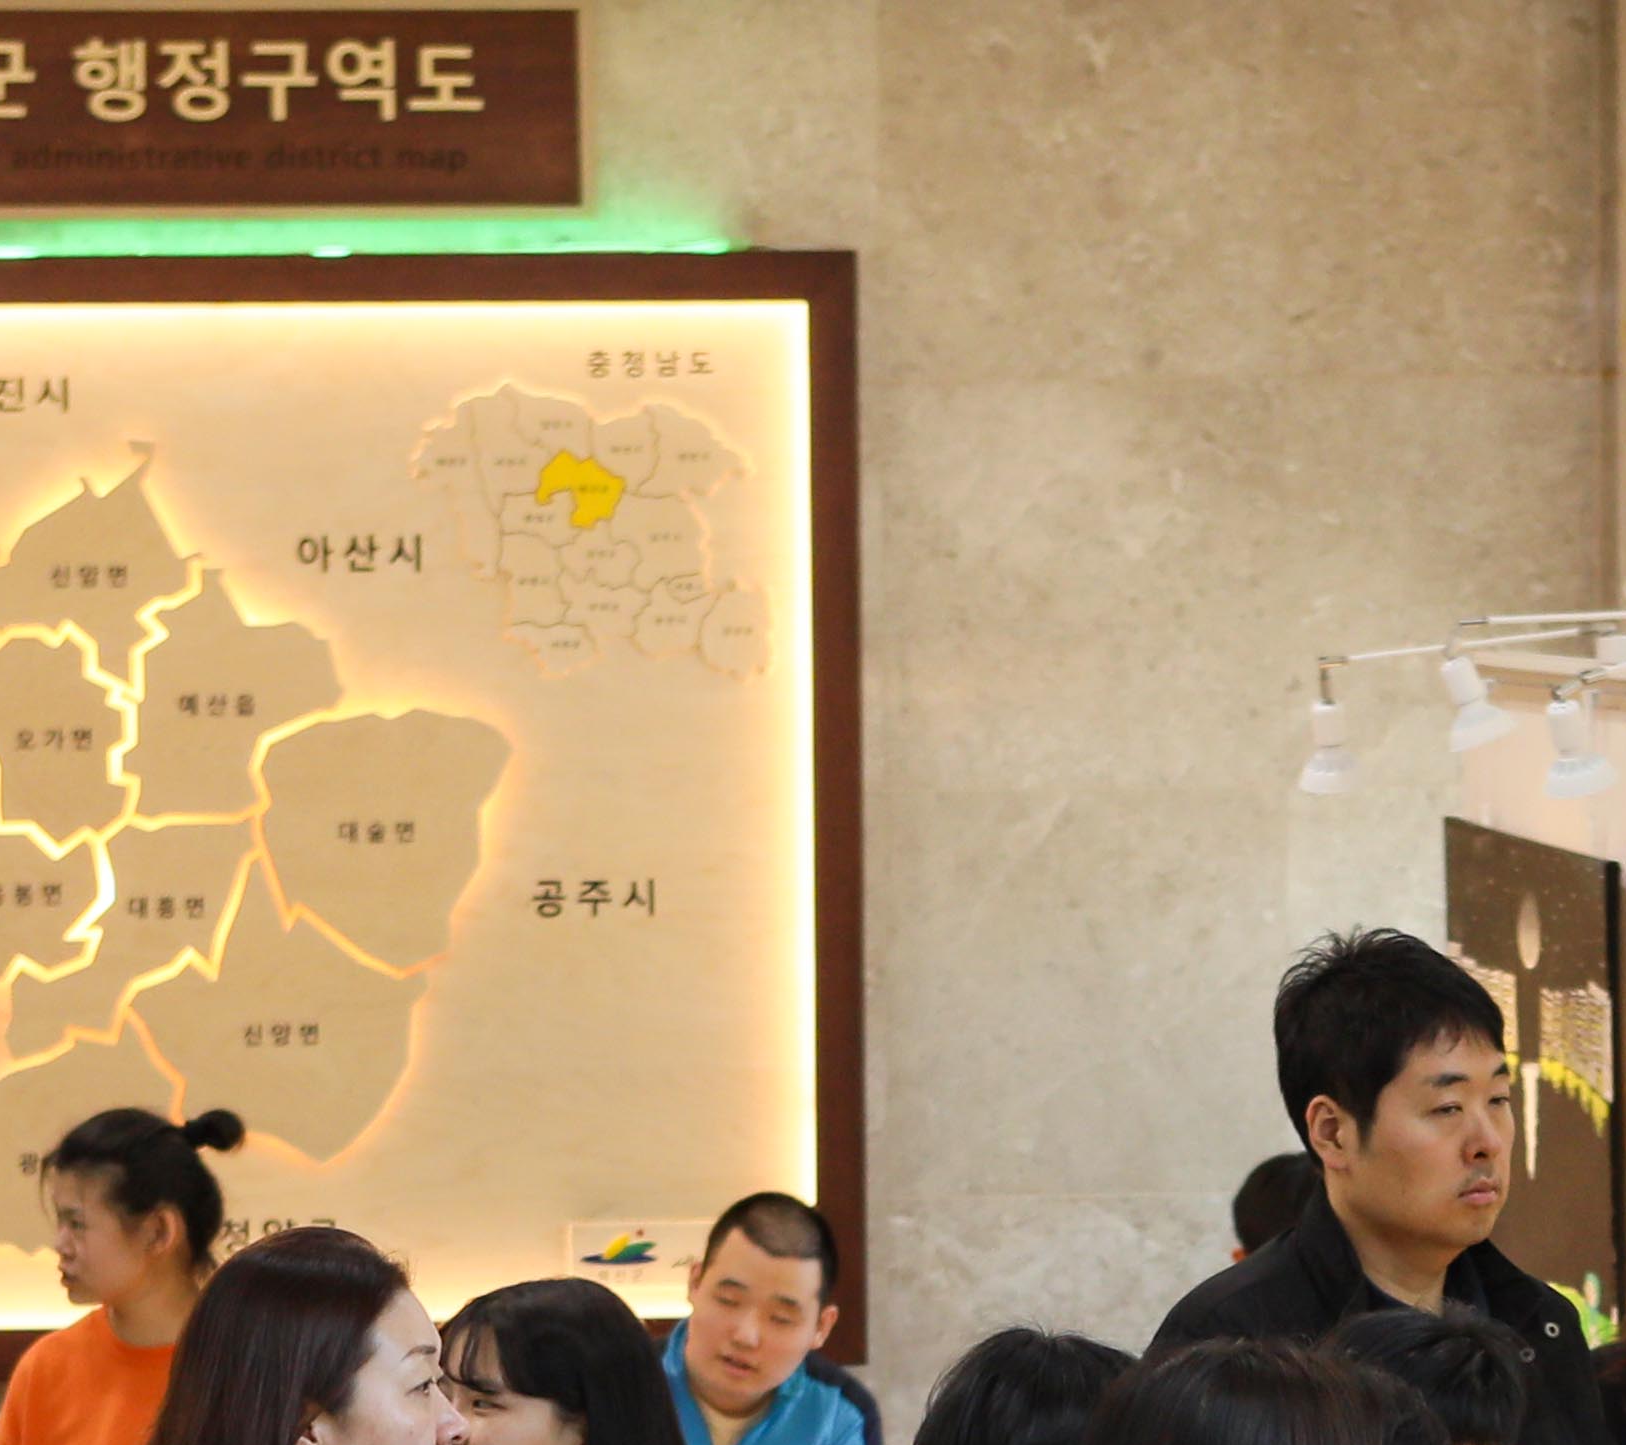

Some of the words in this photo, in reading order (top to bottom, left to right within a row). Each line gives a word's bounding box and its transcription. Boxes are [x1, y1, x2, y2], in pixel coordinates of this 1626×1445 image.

[71, 37, 486, 123] 행정구역도
[587, 350, 715, 378] 충청남도
[297, 534, 423, 573] 아산시
[178, 693, 255, 717] 예산읍
[16, 728, 93, 752] 오가면
[338, 820, 415, 844] 대술면
[532, 878, 656, 919] 공주시
[244, 1022, 320, 1047] 신양면
